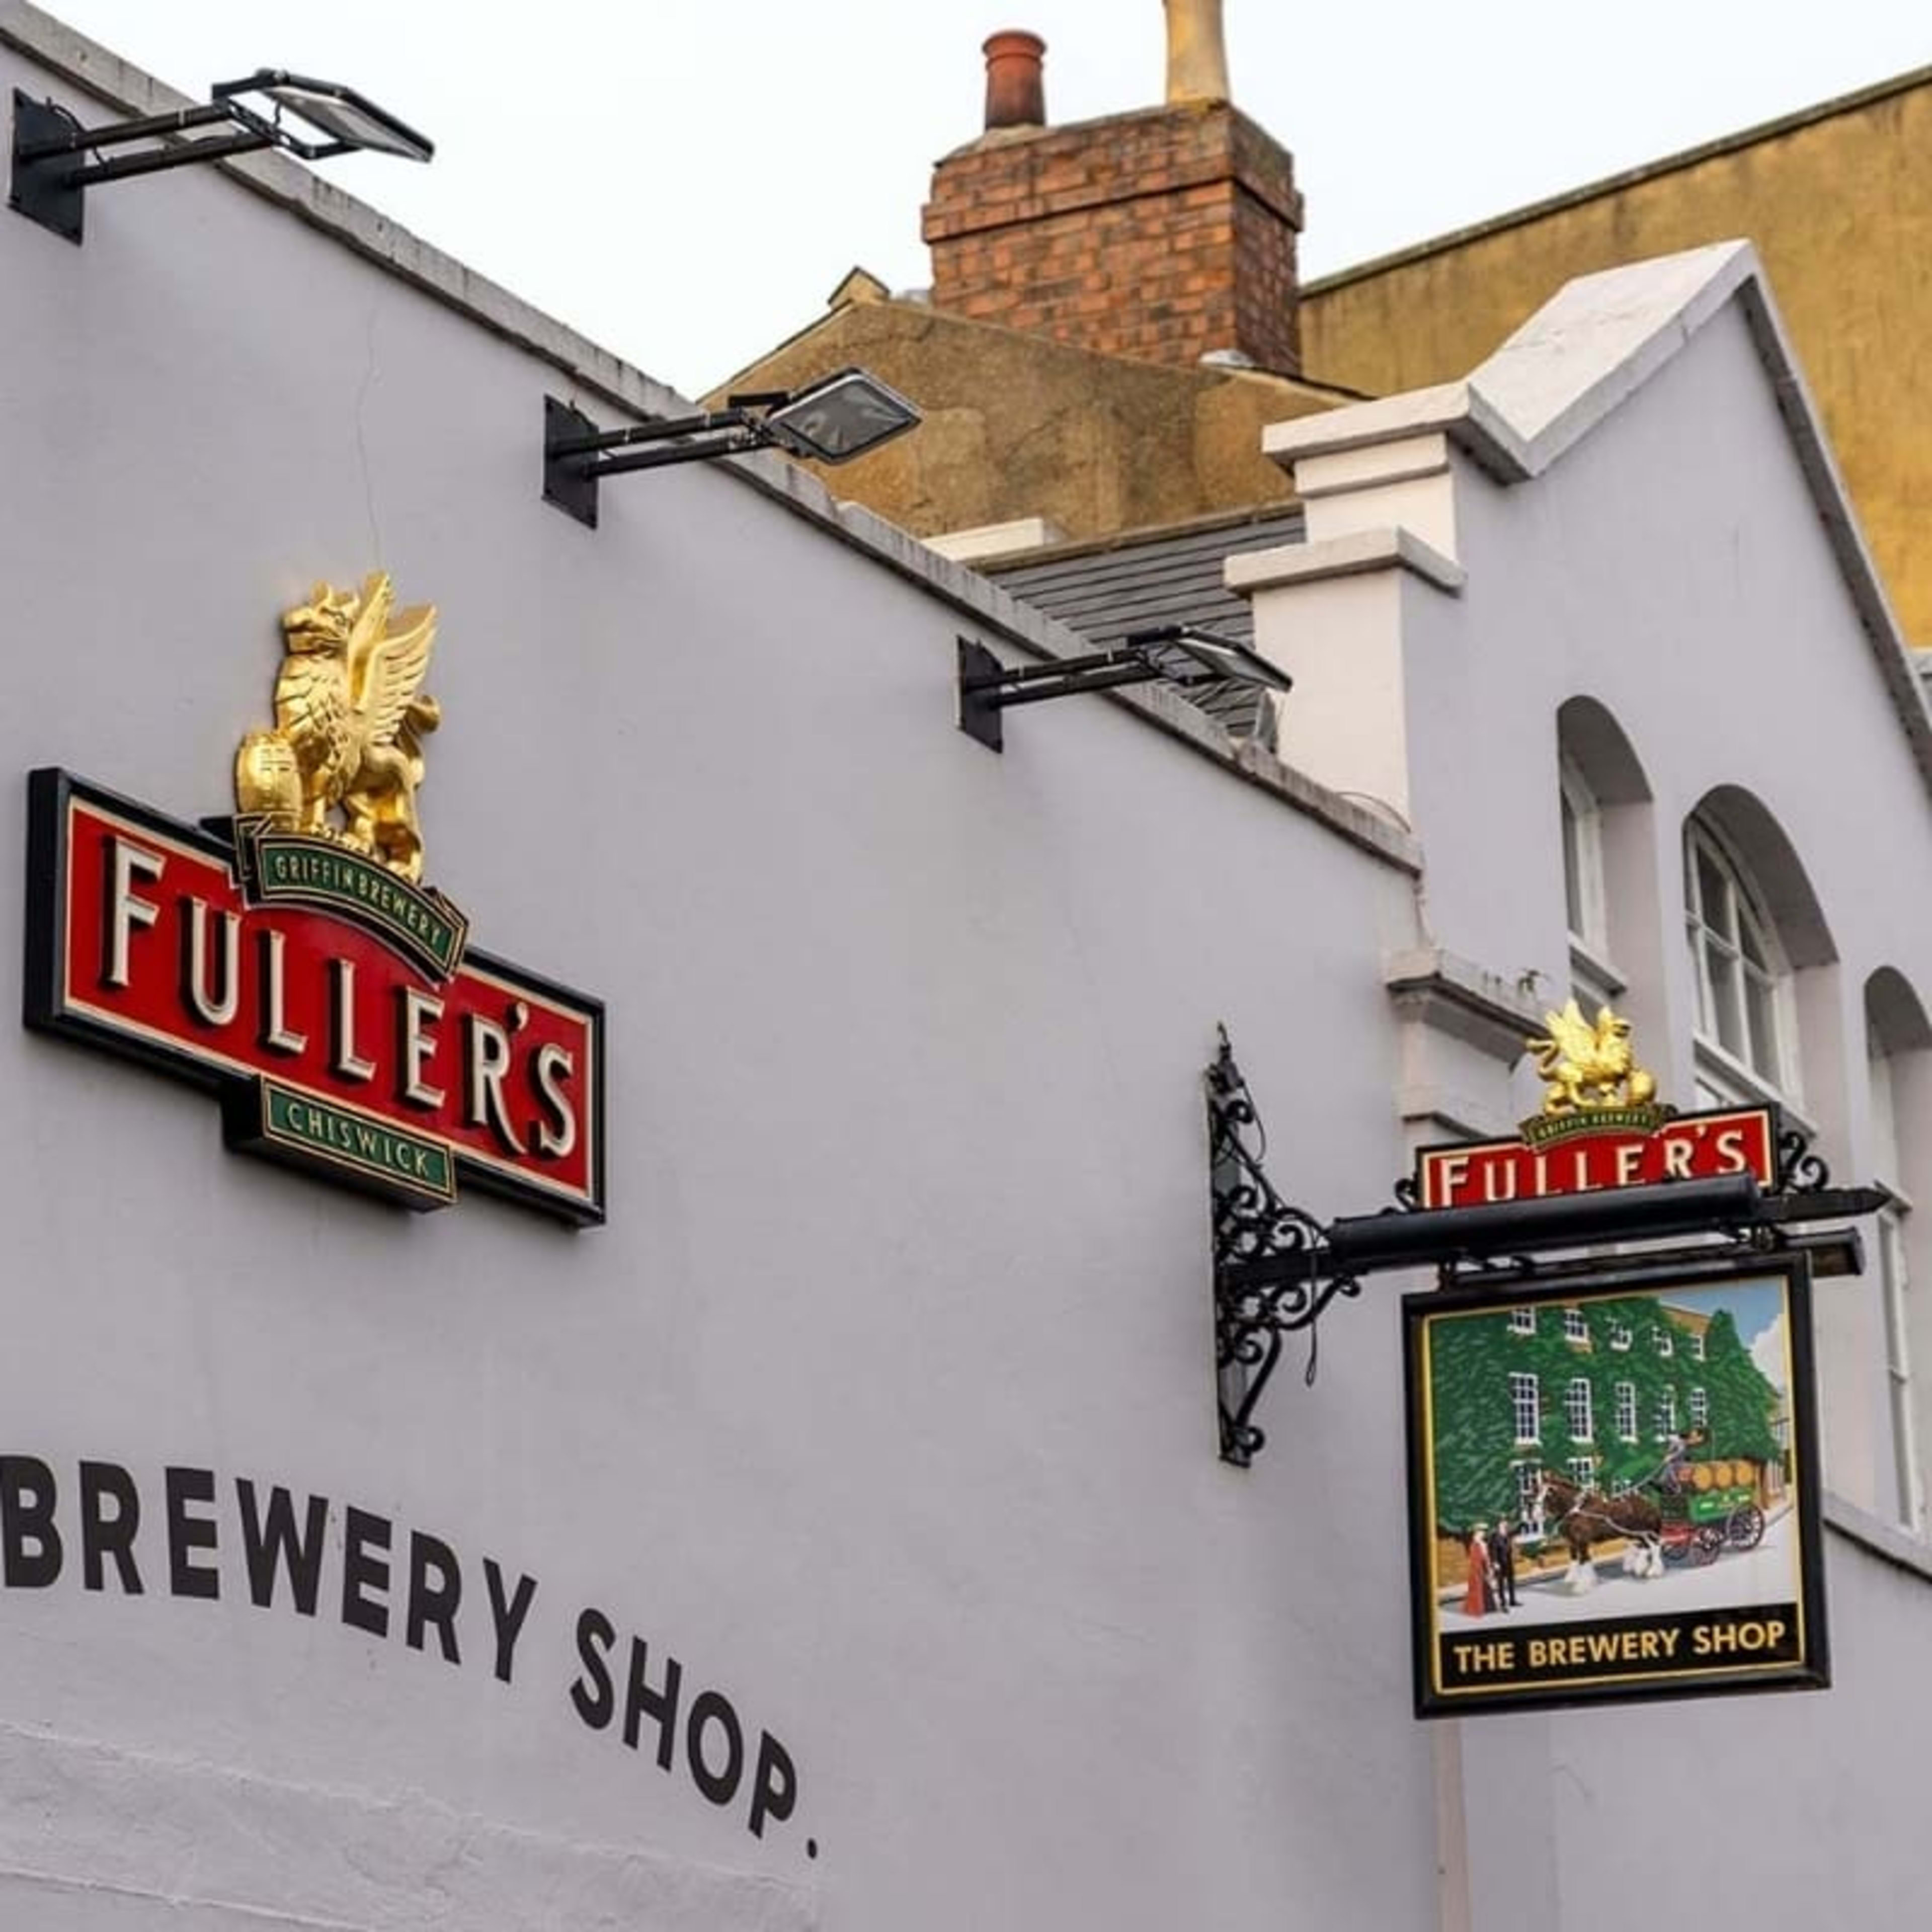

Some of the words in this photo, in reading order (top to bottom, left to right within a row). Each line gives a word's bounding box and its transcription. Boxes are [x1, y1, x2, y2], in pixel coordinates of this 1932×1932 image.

[275, 855, 353, 885] GRIFFIN
[358, 872, 443, 946] BREWERY
[108, 834, 576, 1158] FULLER'S
[286, 1103, 428, 1177] CHISWICK
[1439, 1125, 1746, 1208] FULLER'S
[0, 1453, 537, 1684] BREWERY
[569, 1607, 818, 1860] SHOP.
[1454, 1641, 1514, 1673] THE
[1528, 1628, 1680, 1667] BREWERY
[1692, 1620, 1786, 1654] SHOP
